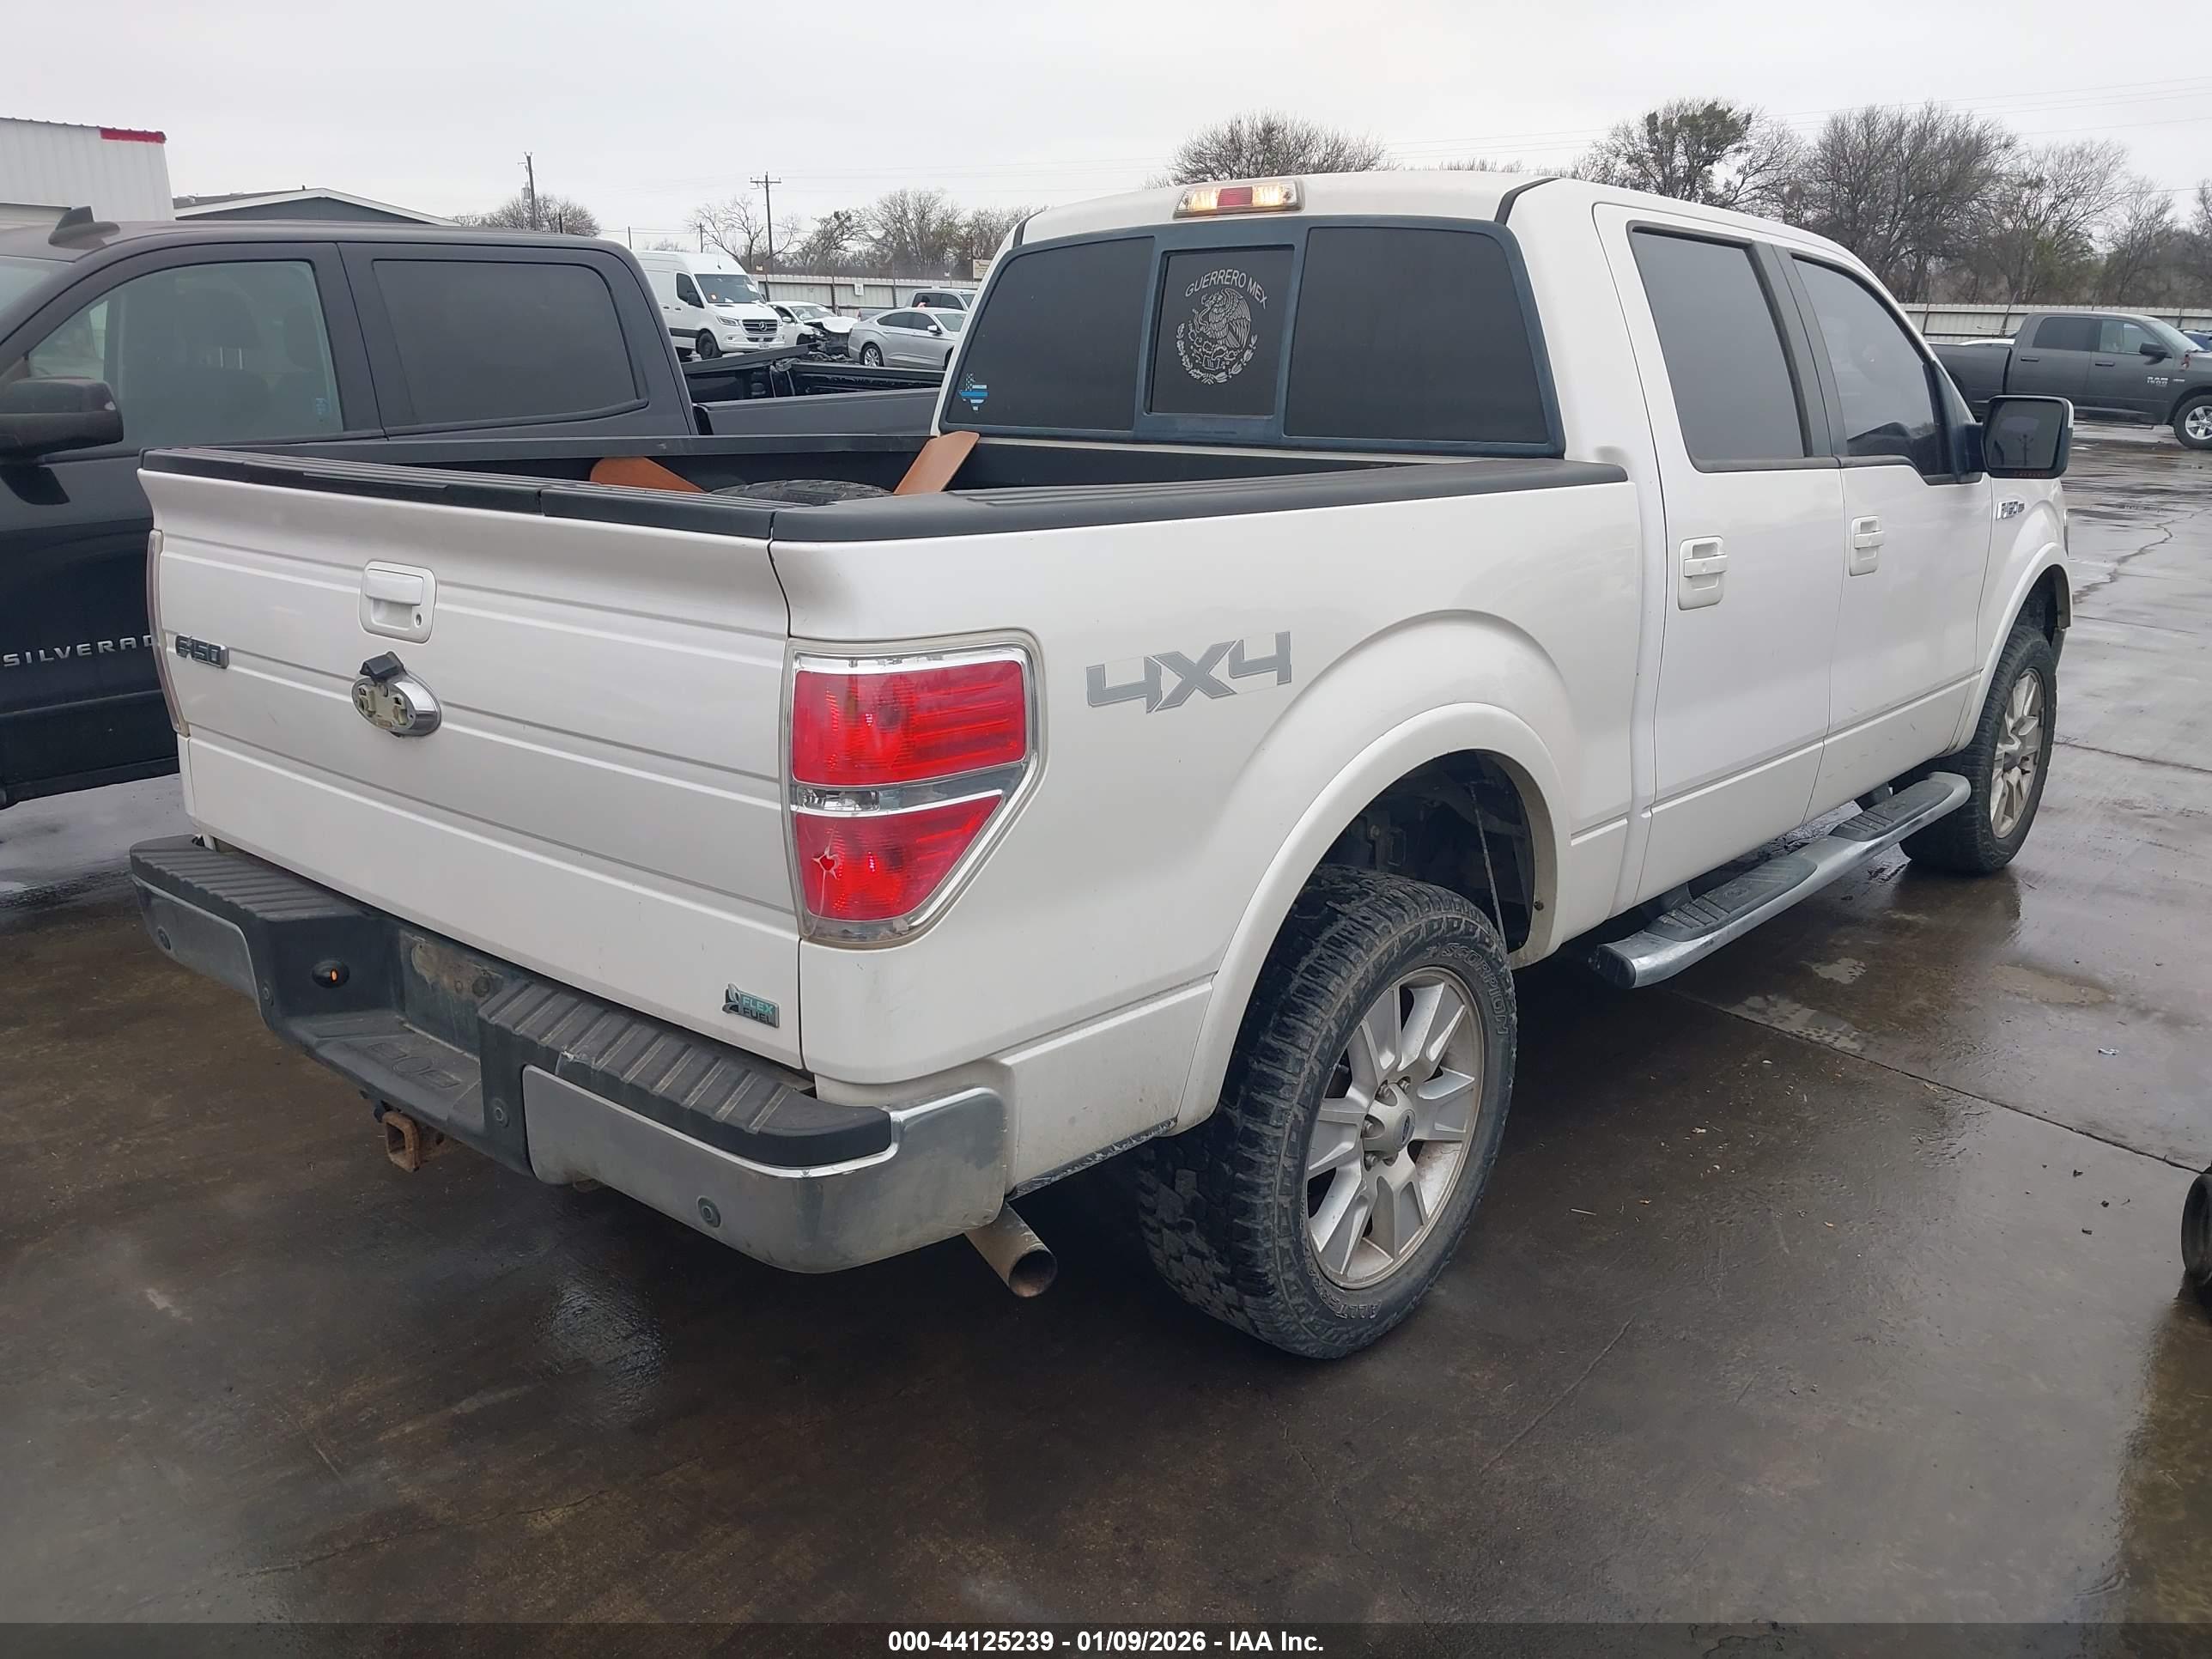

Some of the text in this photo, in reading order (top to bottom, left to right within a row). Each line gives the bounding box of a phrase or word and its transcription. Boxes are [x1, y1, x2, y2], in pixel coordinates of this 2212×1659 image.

[1185, 269, 1267, 309] GUERRERO MEX
[1085, 630, 1291, 714] 4X4
[742, 996, 774, 1015] FLEX
[743, 1007, 773, 1024] FUEL
